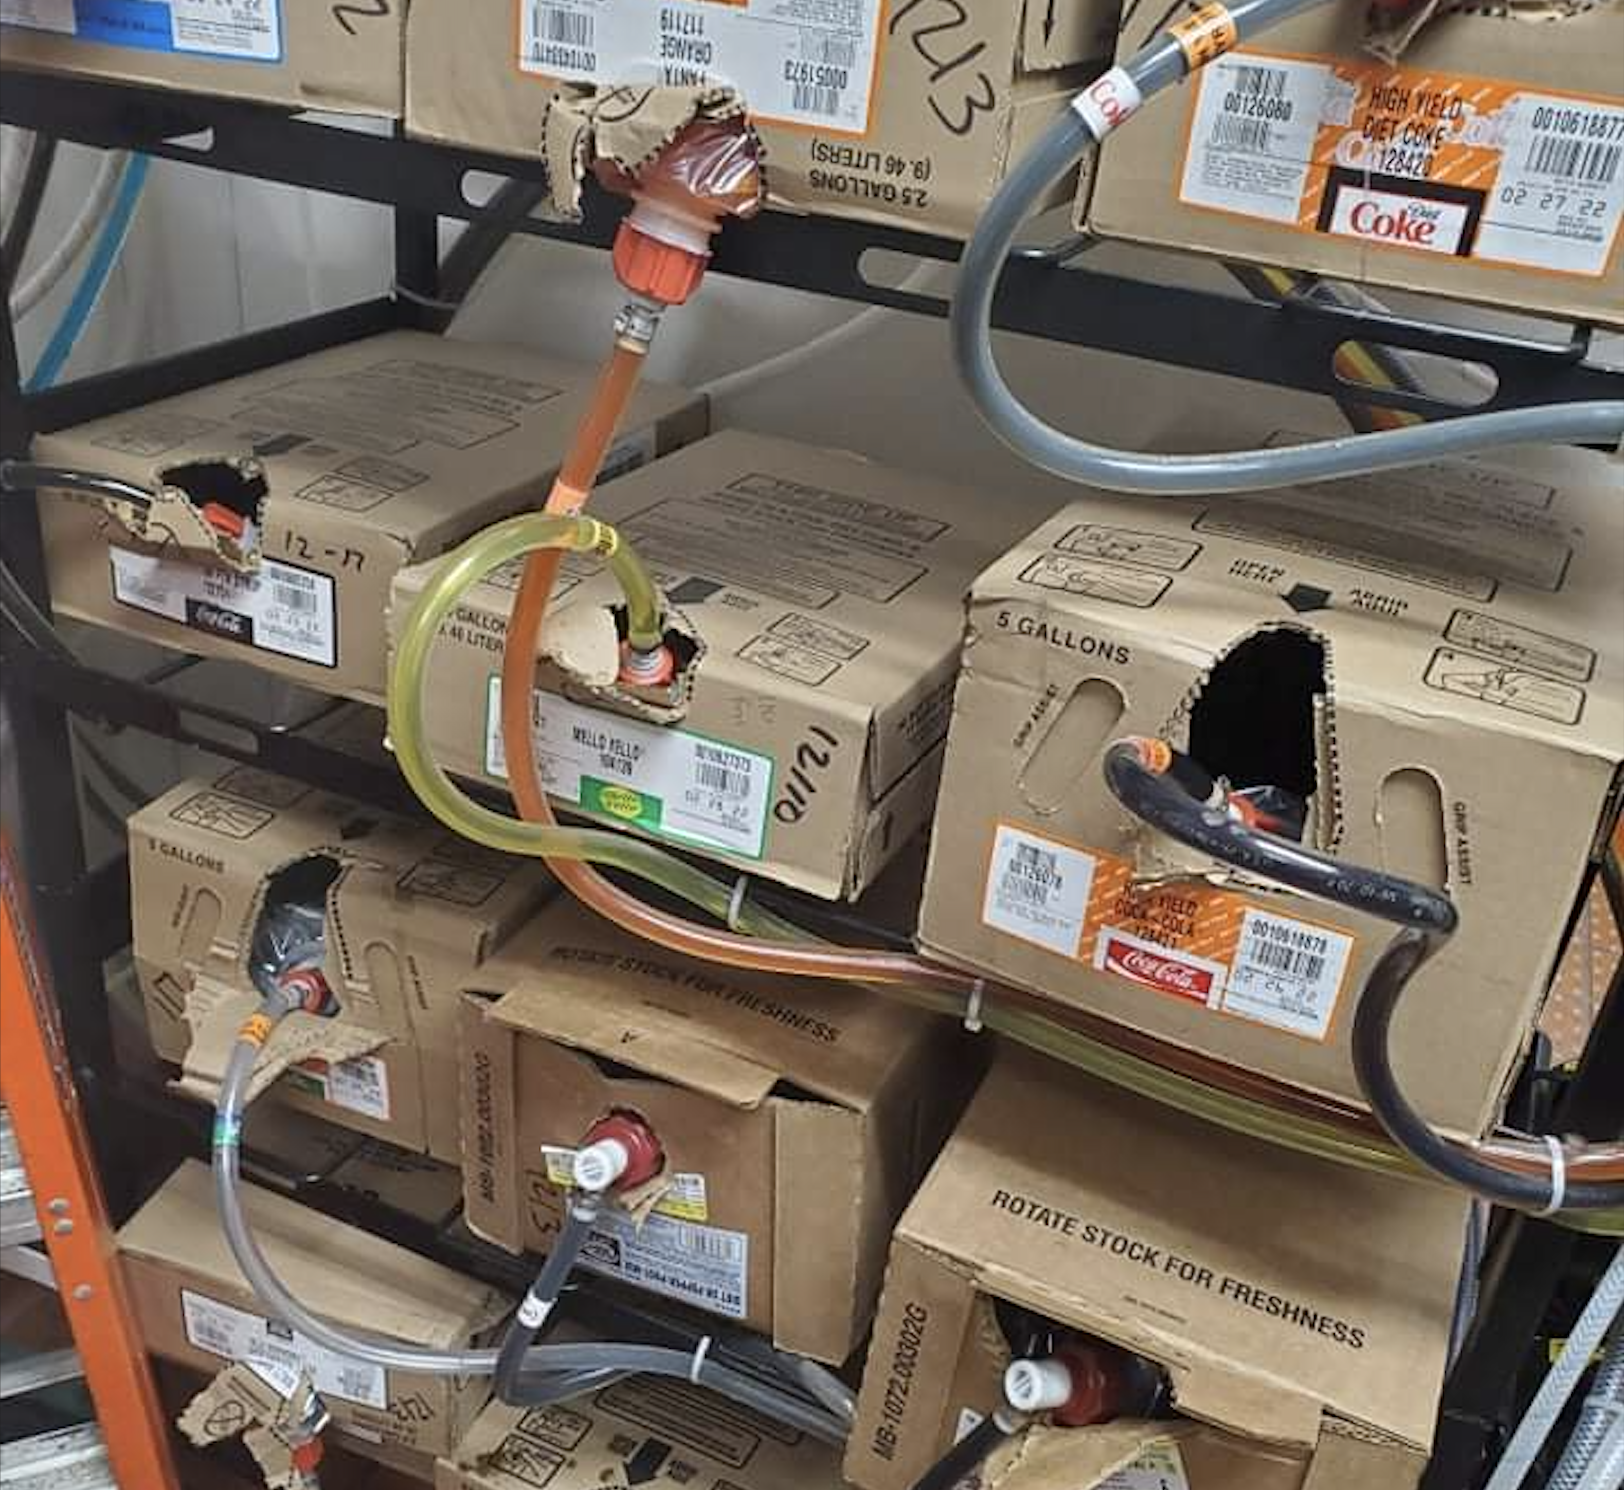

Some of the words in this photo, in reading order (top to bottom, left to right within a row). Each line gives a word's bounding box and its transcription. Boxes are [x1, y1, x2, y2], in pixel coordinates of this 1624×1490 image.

[661, 36, 712, 65] ORANGE
[1370, 87, 1411, 113] HIGH
[1417, 90, 1462, 119] YIELD
[1363, 115, 1399, 141] DIET
[1403, 122, 1446, 150] COKE
[812, 138, 880, 165] LITERS)
[810, 169, 896, 201] GALLONS
[1500, 186, 1529, 205] 02
[1540, 194, 1566, 211] 27
[1578, 199, 1607, 218] 22
[1350, 201, 1437, 245] Coke
[997, 611, 1011, 628] 5
[1018, 617, 1130, 665] GALLONS
[160, 843, 224, 874] GALLONS
[1122, 951, 1193, 989] Coca-Cola
[726, 987, 842, 1042] FRESHNESS
[992, 1190, 1078, 1236] ROTATE
[1082, 1225, 1160, 1269] STOCK
[1163, 1256, 1215, 1289] FOR
[1219, 1278, 1366, 1350] FRESHNESS
